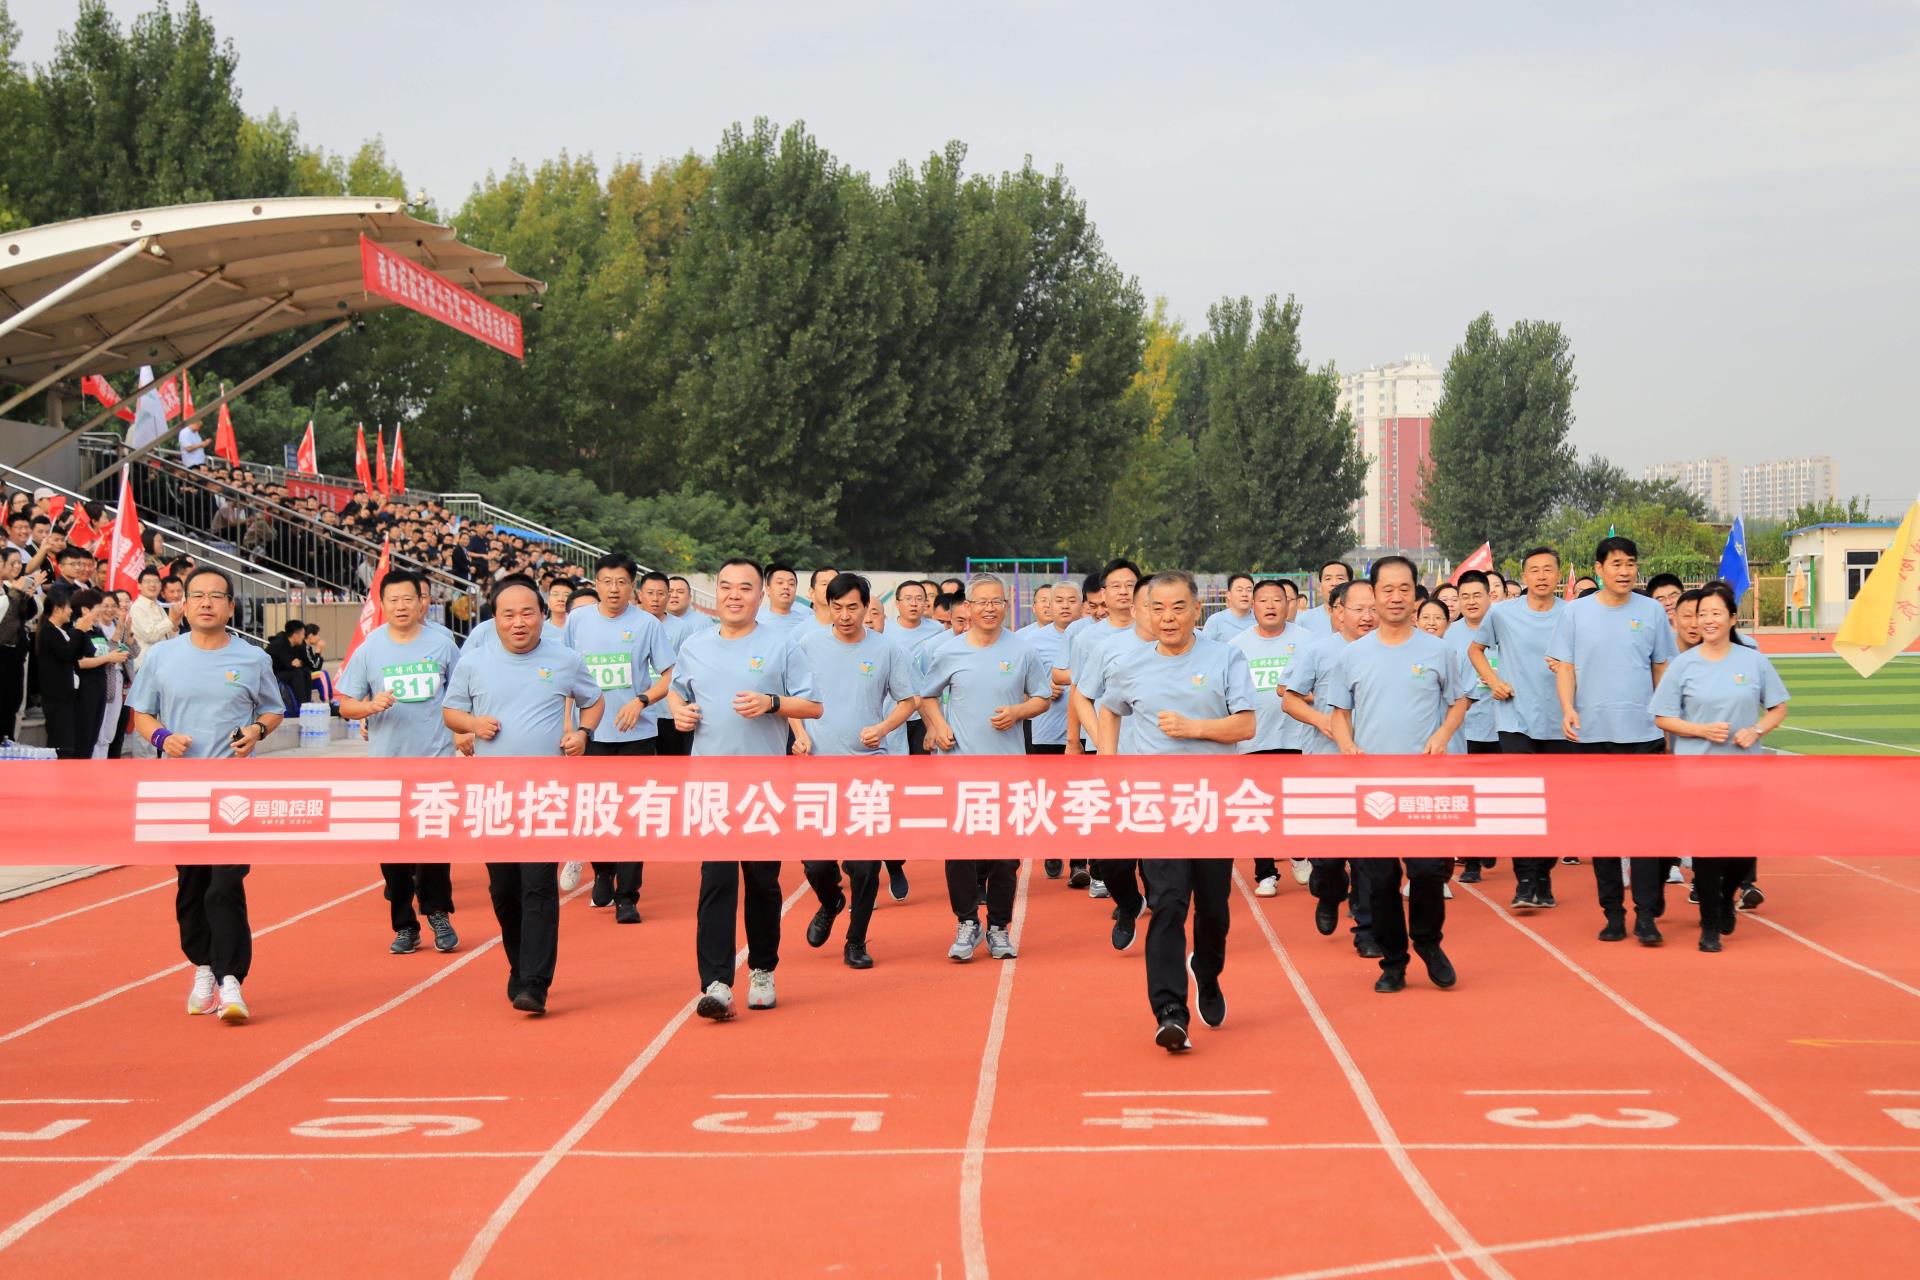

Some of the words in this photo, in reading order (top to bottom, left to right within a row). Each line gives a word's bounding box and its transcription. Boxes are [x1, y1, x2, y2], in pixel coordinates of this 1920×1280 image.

[591, 667, 625, 684] 101
[1254, 670, 1279, 686] 78
[391, 677, 434, 697] 811
[253, 800, 324, 817] 香驰控股
[409, 778, 1275, 839] 香驰控股有限公司第二届秋季运动会
[1398, 796, 1469, 812] 香驰控股
[289, 1114, 484, 1138] 6
[692, 1111, 884, 1134] 5
[1082, 1108, 1268, 1129] 4
[1485, 1107, 1680, 1129] 3
